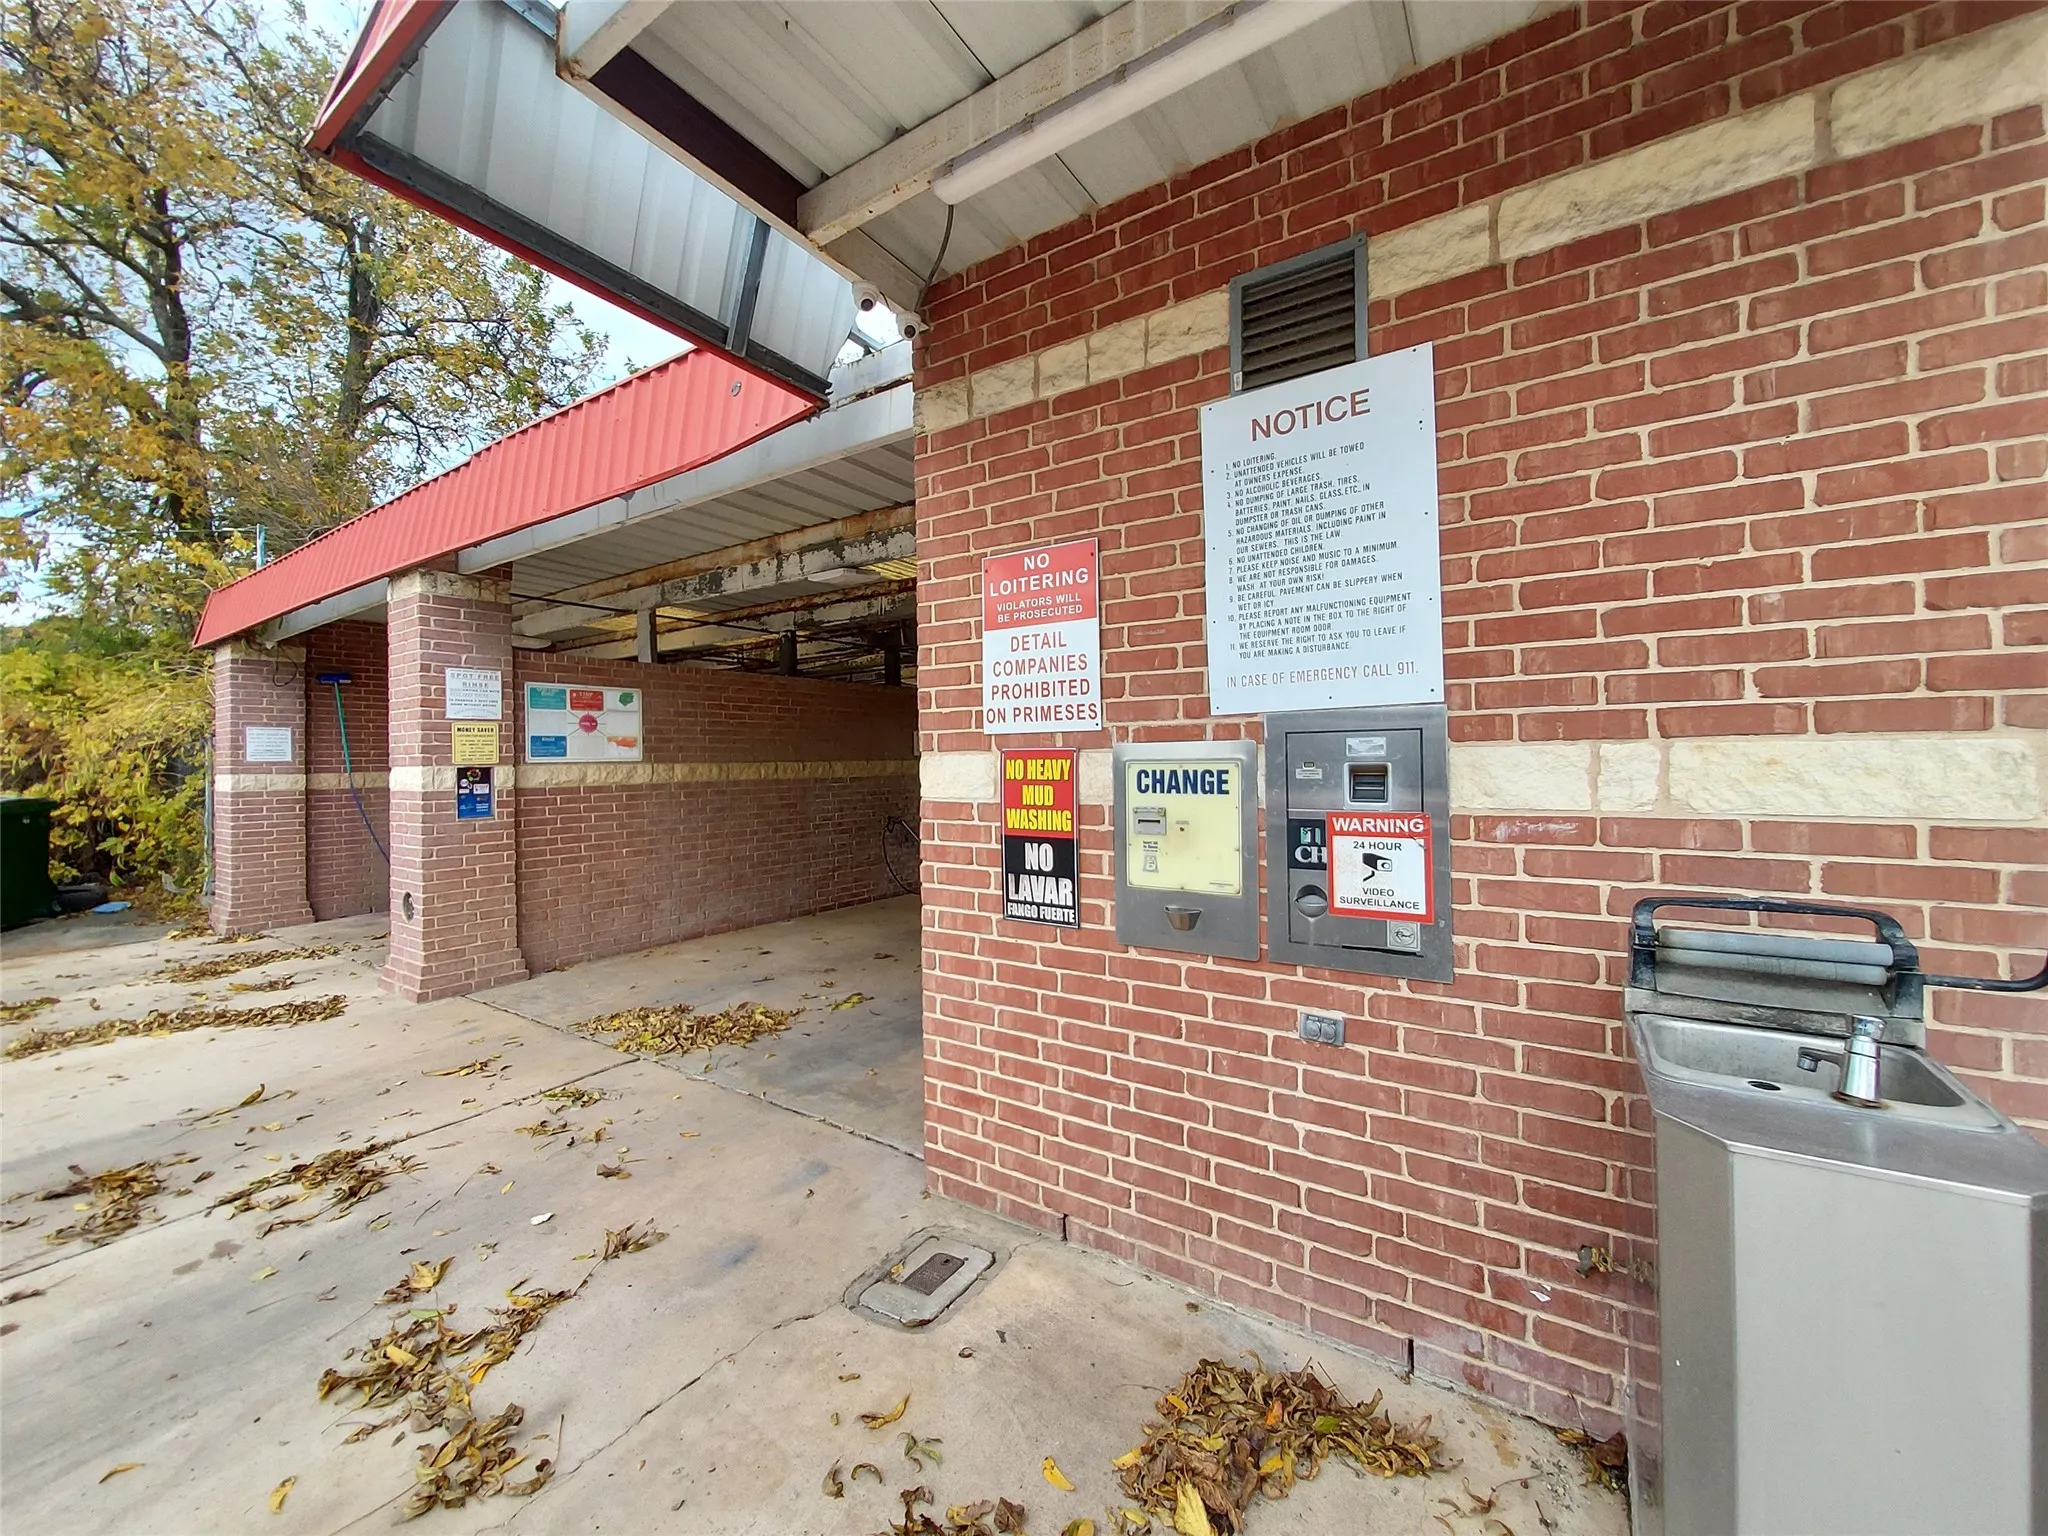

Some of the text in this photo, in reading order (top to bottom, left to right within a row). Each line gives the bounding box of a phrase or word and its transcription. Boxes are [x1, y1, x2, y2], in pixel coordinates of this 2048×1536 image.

[1252, 388, 1370, 441] NOTICE
[1232, 460, 1240, 468] NO
[1234, 441, 1364, 478] UNATTENDED VEHICLES WILL BE TOWED
[1234, 479, 1241, 487] AT
[1244, 473, 1270, 486] OWNERS
[1234, 489, 1243, 497] NO
[1246, 481, 1279, 495] ALCOHOLIC
[1362, 482, 1370, 491] IN
[1235, 498, 1243, 506] NO
[1246, 492, 1274, 504] DUMPING
[1276, 489, 1284, 498] OF
[1287, 484, 1307, 496] LARGE
[1235, 513, 1268, 526] DUMPSTER
[1270, 510, 1278, 519] OR
[1281, 506, 1302, 517] TRASH
[1236, 501, 1384, 535] NO CHANGING OF OIL OR DUMPING OF OTHER
[1236, 531, 1272, 544] HAZARDOUS
[1316, 516, 1352, 530] INCLUDING
[1355, 512, 1375, 524] PAINT
[1378, 511, 1386, 519] IN
[1236, 545, 1248, 554] OUR
[1284, 536, 1298, 546] THIS
[1301, 535, 1308, 543] IS
[1310, 532, 1323, 541] THE
[1024, 553, 1050, 572] NO
[1236, 562, 1258, 573] PLEASE
[1262, 559, 1278, 569] KEEP
[1280, 556, 1299, 566] NOISE
[1302, 553, 1316, 562] AND
[1318, 549, 1340, 560] MUSIC
[1343, 547, 1352, 556] TO
[1355, 546, 1359, 554] A
[1247, 548, 1288, 562] UNATTENDED
[1237, 574, 1246, 582] WE
[1249, 572, 1260, 580] ARE
[1263, 570, 1275, 578] NOT
[1278, 562, 1322, 576] RESPONSIBLE
[1325, 560, 1338, 569] FOR
[990, 568, 1089, 597] LOITERING
[1236, 583, 1254, 592] WASH
[1269, 578, 1285, 587] YOUR
[1288, 576, 1303, 585] OWN
[1306, 573, 1324, 582] RISK!
[1237, 572, 1402, 602] BE PAVEMENT CAN BE SLIPPERY WHEN
[997, 593, 1082, 612] VIOLATORS WILL
[998, 604, 1083, 623] BE PROSECUTED
[1237, 601, 1261, 611] WET OR
[1238, 592, 1411, 620] PLEASE REPORT ANY MALFUNCTIONING EQUIPMENT
[1248, 619, 1275, 629] PLACING
[1284, 616, 1300, 625] NOTE
[1313, 613, 1325, 621] THE
[1328, 611, 1342, 620] BOX
[1345, 610, 1353, 618] TO
[1356, 607, 1369, 616] THE
[1373, 605, 1394, 614] RIGHT
[1397, 603, 1406, 612] OF
[1010, 631, 1067, 653] DETAIL
[1239, 625, 1310, 639] THE EQUIPMENT ROOM
[1239, 625, 1405, 649] WE RESERVE THE RIGHT TO ASK YOU TO LEAVE IF
[1239, 651, 1250, 659] YOU
[1253, 649, 1265, 657] ARE
[1268, 646, 1293, 656] MAKING
[993, 654, 1088, 678] COMPANIES
[1226, 676, 1236, 688] IN
[1241, 673, 1267, 687] CASE
[1272, 671, 1284, 684] OF
[1289, 666, 1357, 683] EMERGENCY
[1363, 663, 1391, 677] CALL
[478, 674, 500, 682] FREE
[991, 678, 1090, 701] PROHIBITED
[986, 703, 1098, 724] ON PRIMESES
[1005, 759, 1071, 781] NO HEAVY
[1136, 769, 1230, 796] CHANGE
[1022, 785, 1054, 806] MUD
[1006, 808, 1072, 832] WASHING
[1331, 817, 1425, 834] WARNING
[1024, 842, 1054, 872] NO
[1353, 841, 1402, 852] 24 HOUR
[1007, 873, 1074, 907] LAVAR
[1362, 888, 1395, 897] VIDEO
[1007, 902, 1076, 924] FANGO FUERTE
[1339, 896, 1420, 910] SURVEILLANCE
